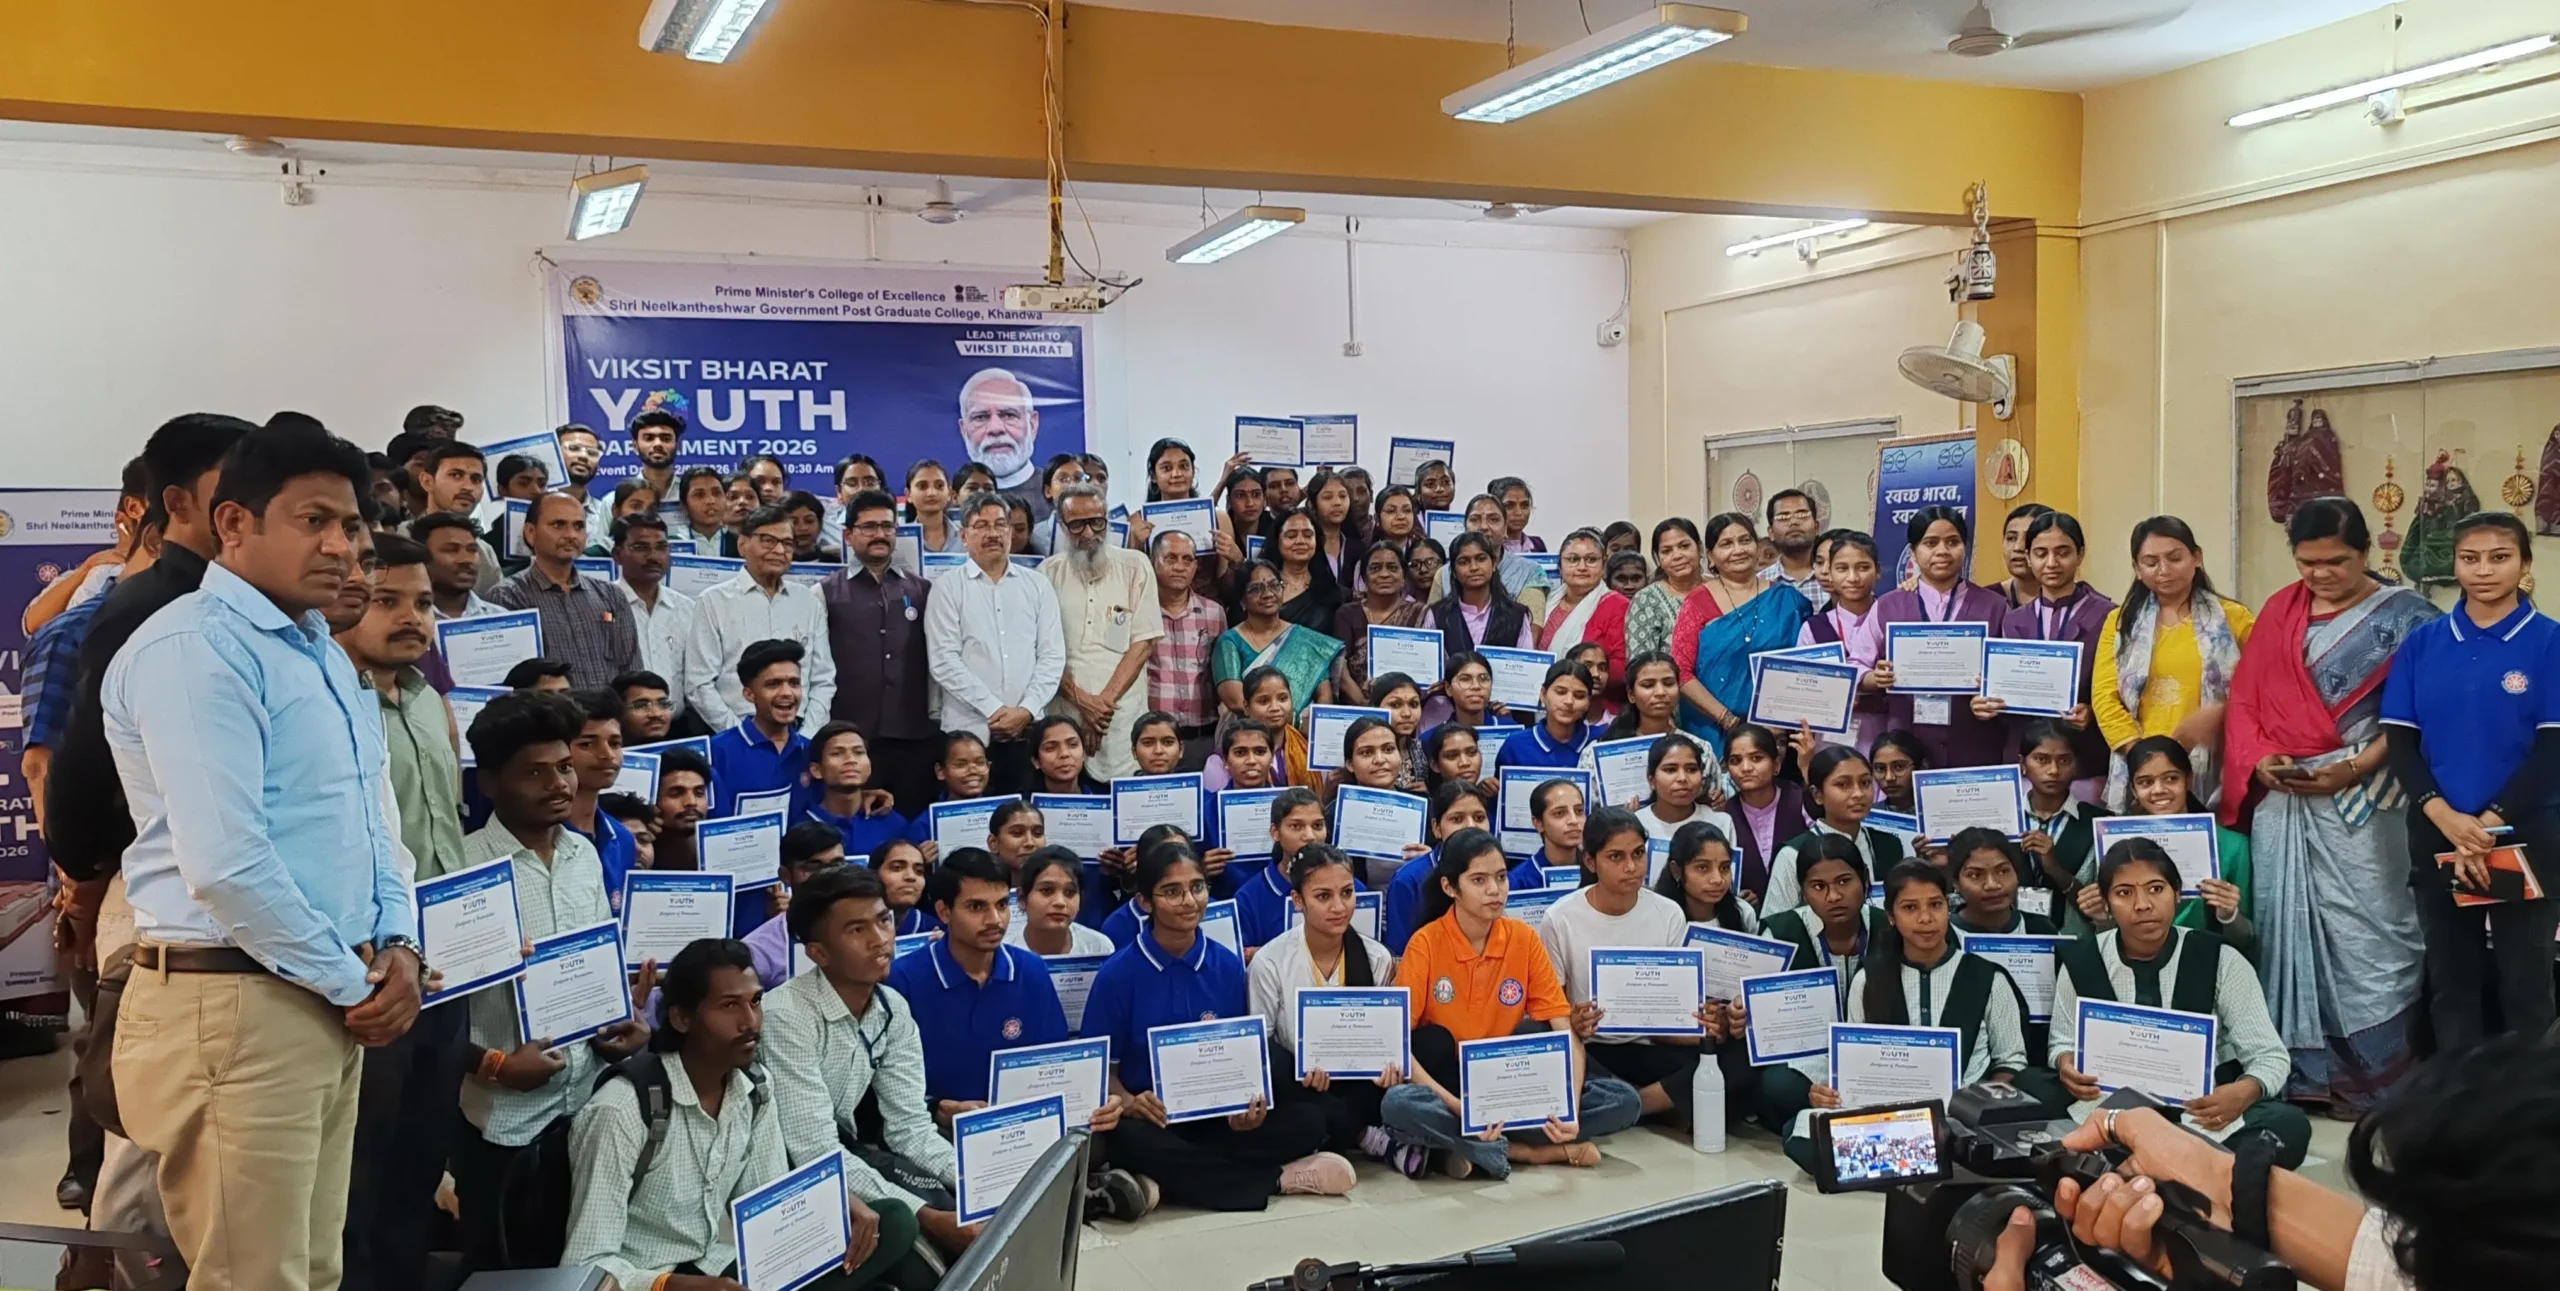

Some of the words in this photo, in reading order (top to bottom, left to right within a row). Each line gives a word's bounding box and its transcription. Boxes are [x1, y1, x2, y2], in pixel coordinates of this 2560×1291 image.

[715, 285, 751, 298] Prime
[755, 286, 815, 299] Minister's
[819, 288, 863, 302] College
[868, 289, 879, 300] of
[883, 290, 946, 302] Excellence
[609, 299, 637, 312] Shri
[641, 300, 755, 314] Neelkantheshwar
[760, 303, 839, 316] Government
[843, 305, 871, 317] Post
[875, 306, 931, 318] Graduate
[935, 307, 985, 321] College,
[988, 309, 1043, 321] Khandwa
[966, 330, 994, 340] LEAD
[997, 331, 1017, 340] THE
[1019, 331, 1045, 341] PATH
[1046, 331, 1061, 341] TO
[964, 344, 1007, 354] VIKSIT
[1012, 344, 1065, 355] BHARAT
[587, 358, 692, 380] VIKSIT
[701, 360, 829, 381] BHARAT
[758, 439, 818, 456] 2026
[814, 463, 834, 474] Am
[1884, 488, 1921, 504] स्वच्छ
[1923, 485, 1962, 503] भारत,
[61, 510, 90, 518] Prime
[26, 522, 48, 531] Shri
